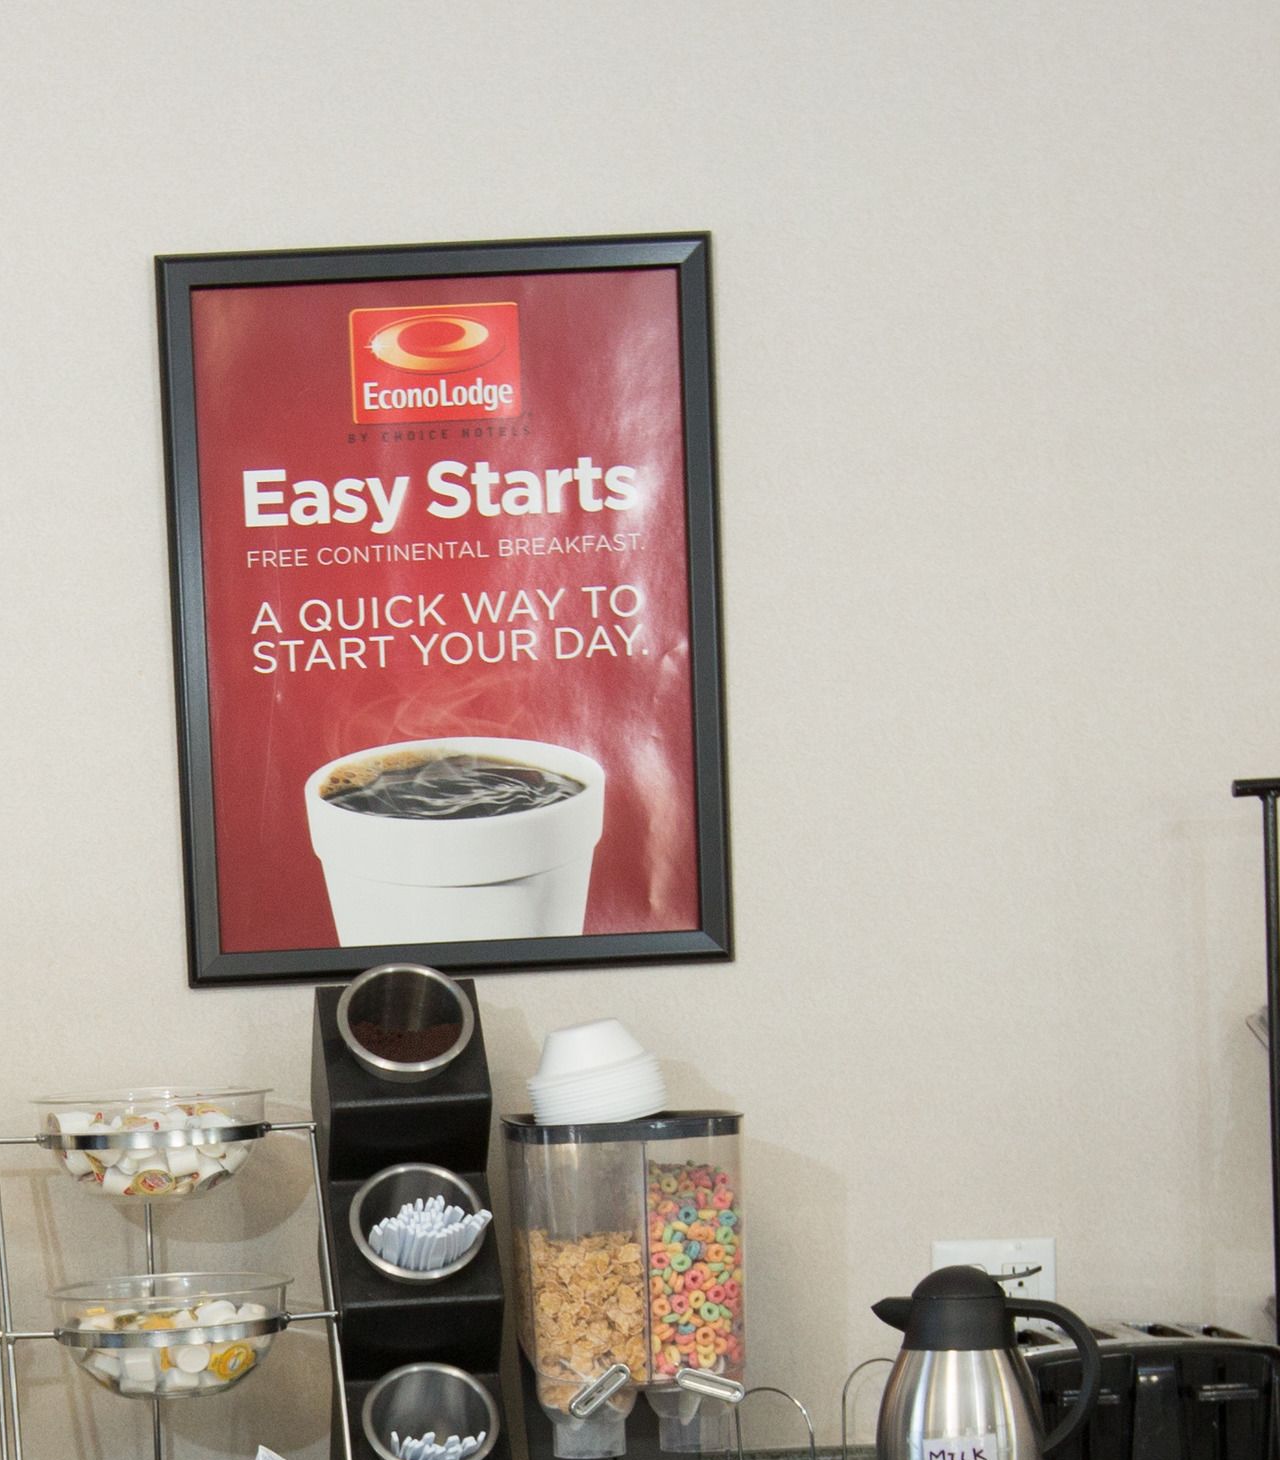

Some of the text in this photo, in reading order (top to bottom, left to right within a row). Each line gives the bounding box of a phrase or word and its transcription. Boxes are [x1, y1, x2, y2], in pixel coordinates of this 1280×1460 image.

[362, 377, 514, 412] EconoLodge
[347, 425, 532, 444] BY CHOICE HOTELS
[242, 456, 639, 534] Easy Starts
[246, 549, 309, 568] FREE
[317, 540, 490, 566] CONTINENTAL
[251, 584, 643, 635] A QUICK WAY TO
[252, 624, 650, 674] START YOUR DAY.
